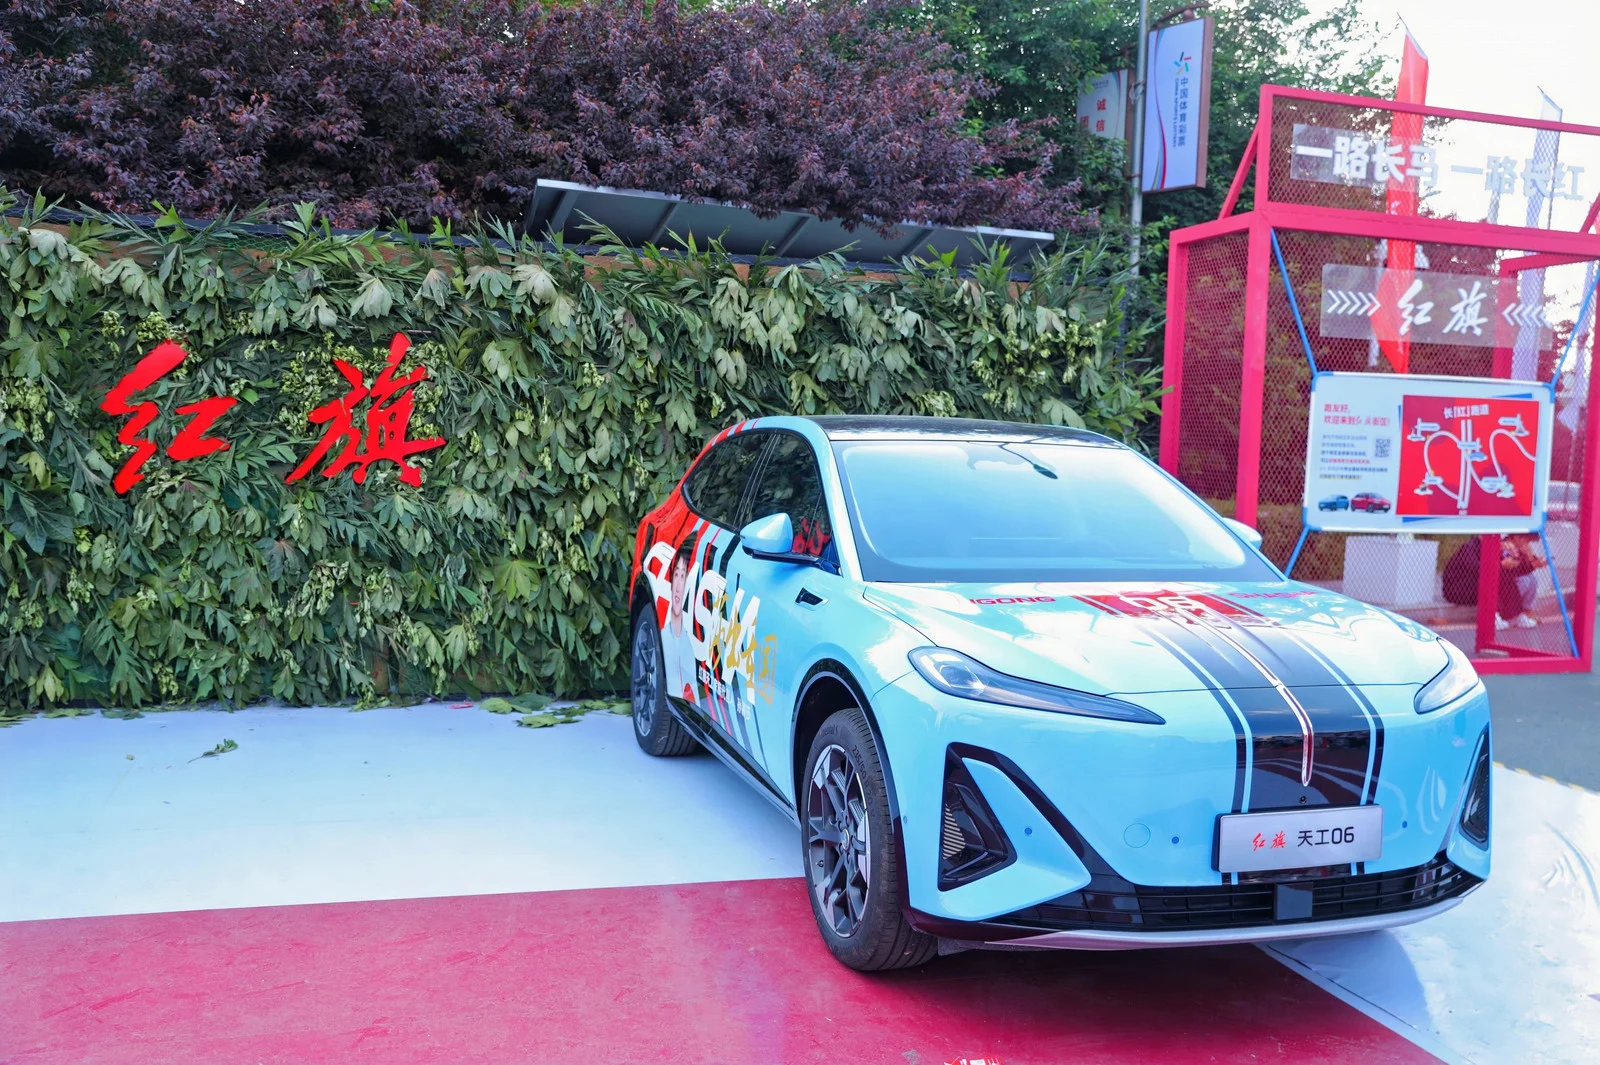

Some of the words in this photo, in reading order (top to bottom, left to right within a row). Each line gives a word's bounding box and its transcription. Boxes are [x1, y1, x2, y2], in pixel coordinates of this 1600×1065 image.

[1178, 77, 1189, 147] 中国体育彩票
[1295, 135, 1438, 188] 一路长马
[1451, 155, 1585, 201] 一路长红
[1397, 278, 1489, 337] 红旗
[99, 331, 447, 495] 红旗
[1251, 830, 1287, 851] 红旗
[1297, 826, 1355, 848] 天工06
